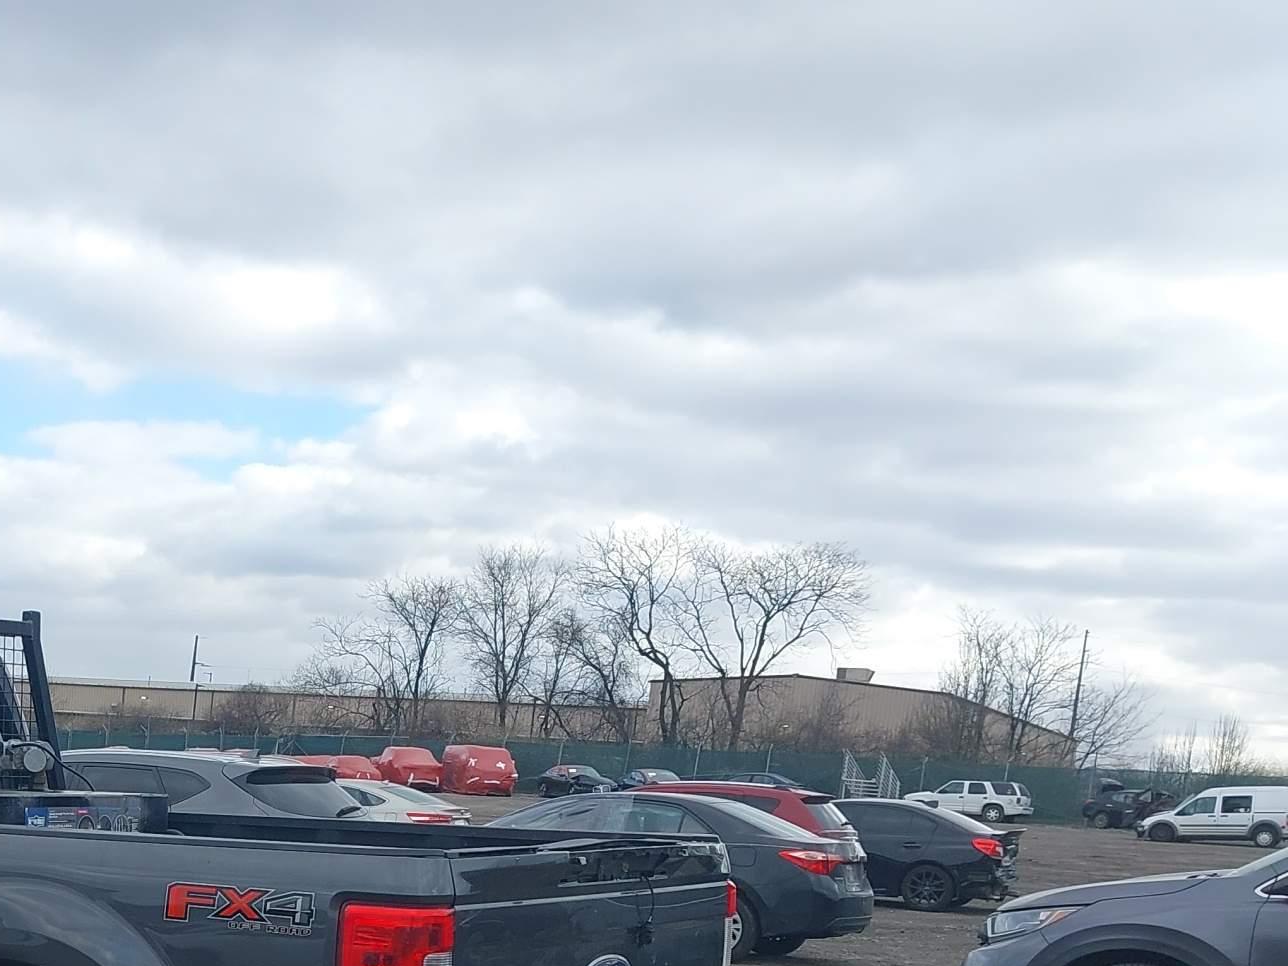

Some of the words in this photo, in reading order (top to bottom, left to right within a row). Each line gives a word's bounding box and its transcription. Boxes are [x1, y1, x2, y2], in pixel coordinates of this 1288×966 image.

[163, 881, 316, 929] FX4
[227, 920, 261, 931] OFF
[265, 924, 313, 937] ROAD
